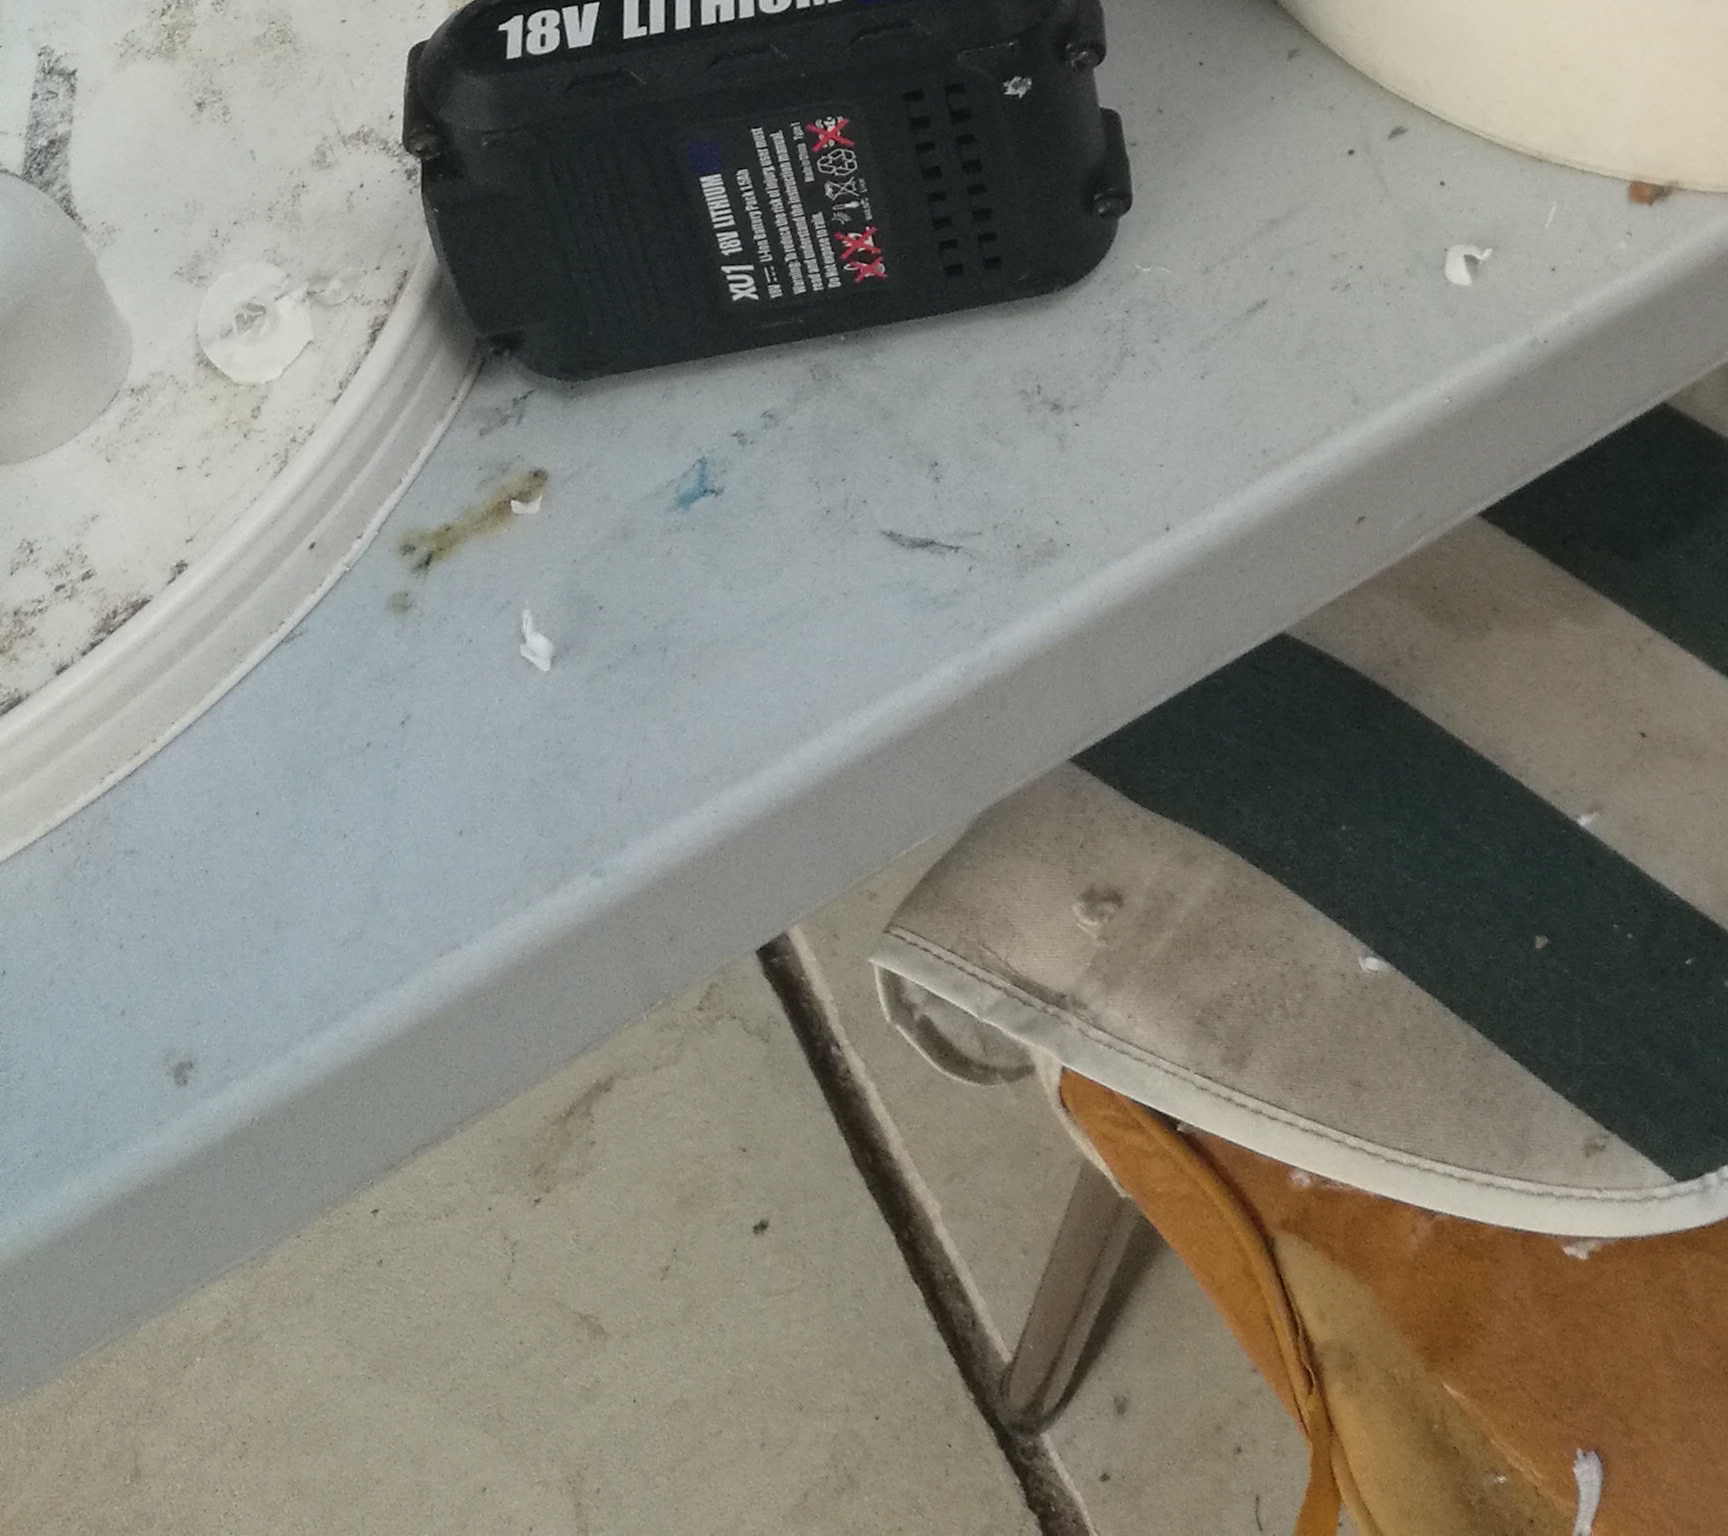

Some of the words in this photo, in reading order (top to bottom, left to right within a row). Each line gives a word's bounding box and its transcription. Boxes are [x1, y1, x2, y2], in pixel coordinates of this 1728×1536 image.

[498, 1, 600, 60] 18V
[750, 126, 766, 148] must
[756, 147, 772, 166] user
[766, 188, 780, 198] of
[778, 161, 800, 204] instruction
[699, 173, 737, 230] LITHIUM
[740, 190, 758, 211] Pack
[769, 197, 784, 213] risk
[789, 203, 803, 216] the
[747, 209, 767, 240] Battery
[773, 212, 788, 226] the
[716, 230, 744, 257] 18V
[777, 225, 795, 253] reduce
[792, 215, 814, 259] understand
[817, 236, 836, 264] expose
[805, 258, 818, 273] and
[720, 264, 760, 302] XU1
[809, 272, 823, 291] read
